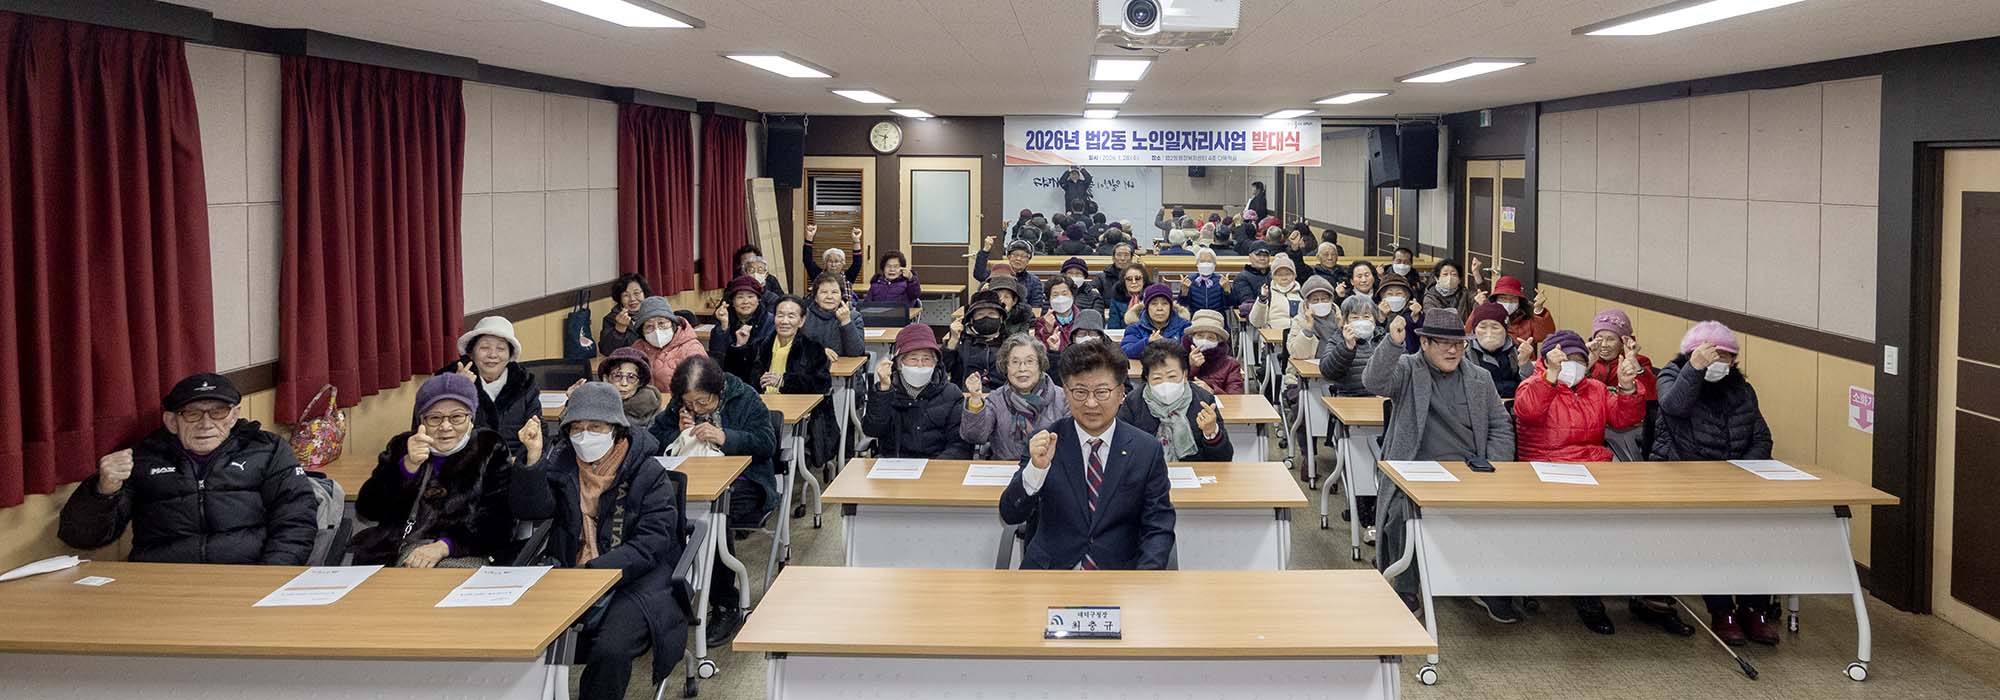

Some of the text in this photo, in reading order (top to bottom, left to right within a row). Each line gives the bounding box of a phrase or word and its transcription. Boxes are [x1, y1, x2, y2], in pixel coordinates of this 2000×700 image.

[1025, 130, 1300, 152] 2026년 법2동 노인일자리사업 발대식
